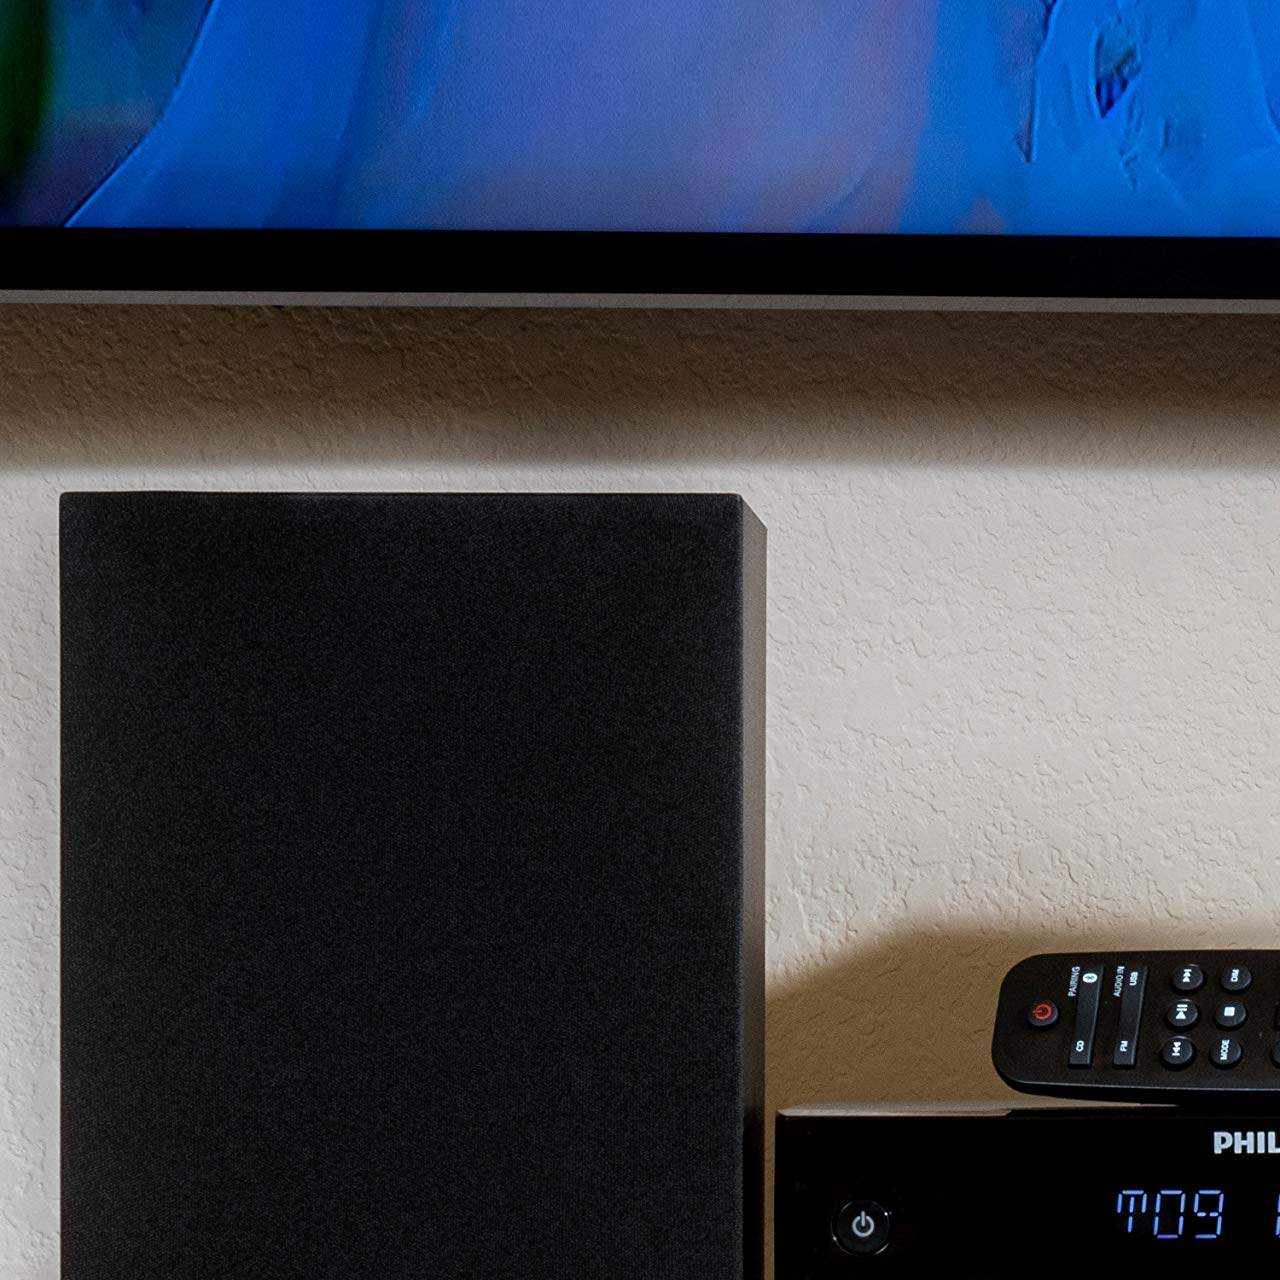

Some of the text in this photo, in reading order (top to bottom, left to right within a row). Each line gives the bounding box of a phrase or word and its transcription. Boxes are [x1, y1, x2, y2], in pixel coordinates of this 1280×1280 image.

[1067, 966, 1081, 997] PAIRING
[1129, 971, 1139, 986] USB
[1230, 968, 1240, 983] DIM
[1113, 974, 1124, 998] AUDIO
[1075, 1040, 1085, 1053] CD
[1119, 1040, 1129, 1052] FM
[1219, 1039, 1230, 1061] MODE
